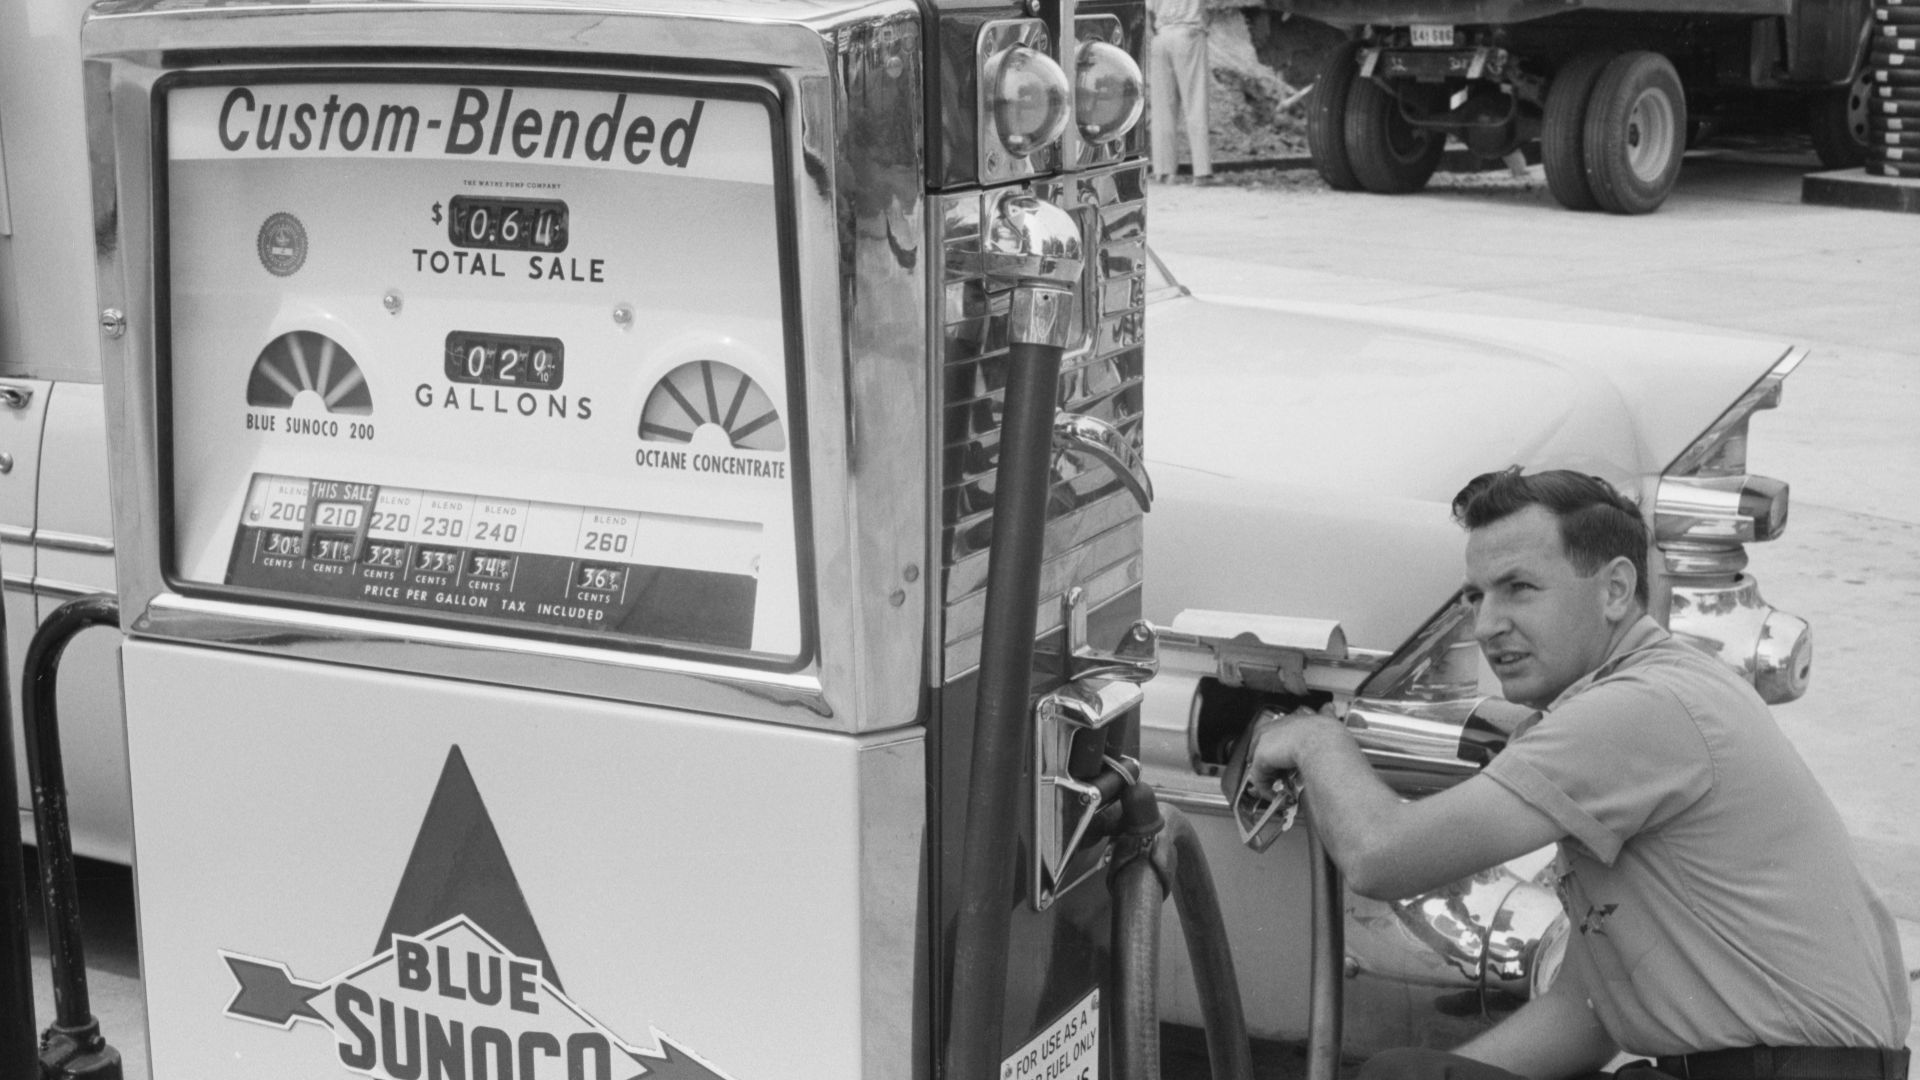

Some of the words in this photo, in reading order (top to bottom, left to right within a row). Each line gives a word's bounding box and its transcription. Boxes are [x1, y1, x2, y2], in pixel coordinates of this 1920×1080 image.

[218, 87, 705, 169] Custom-Blended
[527, 182, 562, 190] COMPANY
[431, 201, 443, 226] $
[412, 249, 506, 277] TOTAL
[528, 255, 605, 283] SALE
[415, 383, 592, 420] GALLONS
[246, 413, 276, 431] BLUE
[286, 416, 339, 437] SUNOCO
[350, 422, 375, 440] 200
[636, 448, 687, 470] OCTANE
[693, 453, 785, 479] CONCENTRATE
[311, 481, 339, 499] THIS
[343, 483, 375, 501] SALE
[380, 495, 411, 506] BLEND
[270, 502, 307, 522] 200
[322, 507, 357, 527] 210
[431, 501, 463, 511] BLEND
[484, 505, 517, 516] BLEND
[370, 511, 411, 533] 220
[422, 516, 463, 538] 230
[593, 515, 628, 526] BLEND
[474, 521, 517, 543] 240
[584, 531, 628, 553] 260
[263, 557, 293, 568] CENTS
[313, 563, 343, 575] CENTS
[363, 569, 395, 580] CENTS
[415, 574, 447, 586] CENTS
[468, 580, 501, 592] CENTS
[364, 584, 400, 599] PRICE
[406, 589, 428, 601] PER
[435, 592, 488, 608] GALLON
[501, 599, 526, 613] TAX
[538, 603, 604, 621] INCLUDED
[577, 592, 611, 604] CENTS
[396, 939, 540, 1015] BLUE
[334, 982, 612, 1080] SUNOCO
[1016, 1049, 1037, 1080] FOR
[1041, 1030, 1061, 1060] USE
[1064, 1017, 1077, 1043] AS
[1080, 1009, 1087, 1029] A
[1047, 1051, 1071, 1080] FUEL
[1073, 1027, 1096, 1062] ONLY
